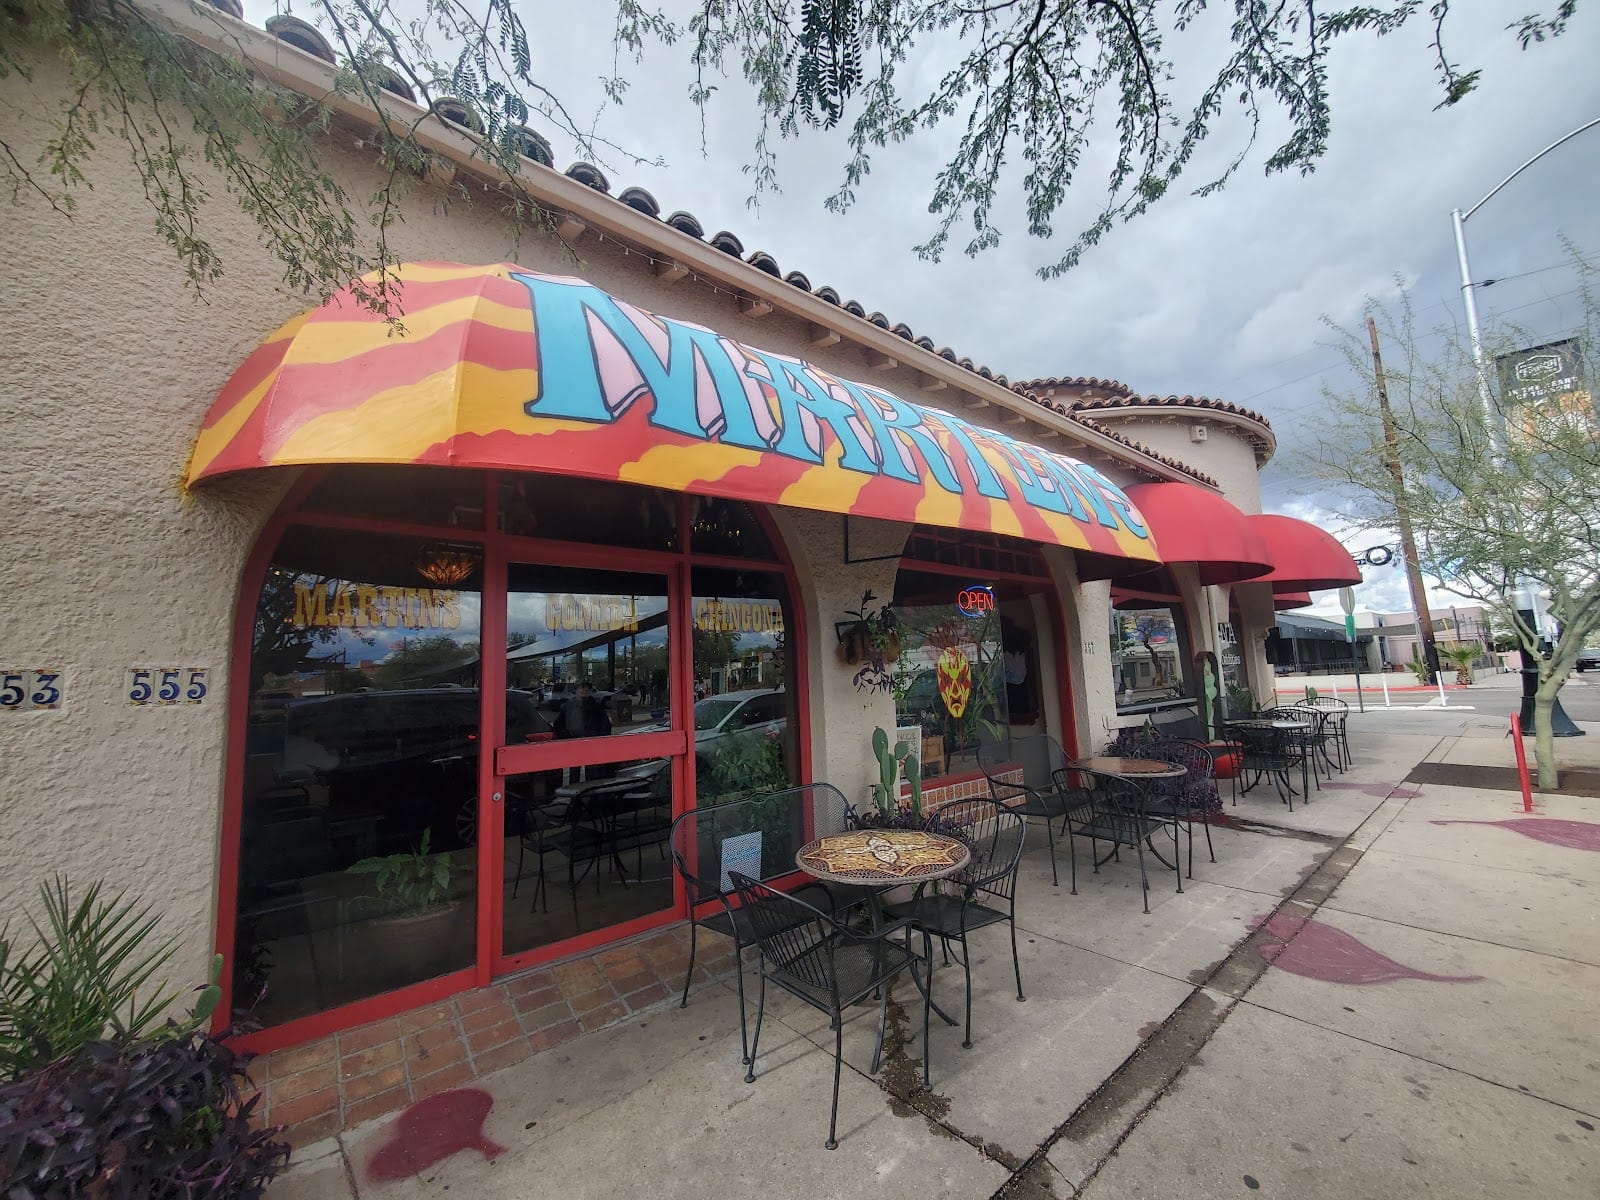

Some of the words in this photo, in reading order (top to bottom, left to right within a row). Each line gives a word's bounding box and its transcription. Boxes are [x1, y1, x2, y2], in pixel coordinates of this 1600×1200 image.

[1530, 384, 1571, 397] TUSON
[293, 582, 461, 630] MARTINS
[545, 594, 639, 632] COMIDA
[696, 600, 785, 633] CHINGONA
[957, 590, 994, 612] OPEN
[0, 674, 60, 706] 53
[129, 671, 207, 701] 555
